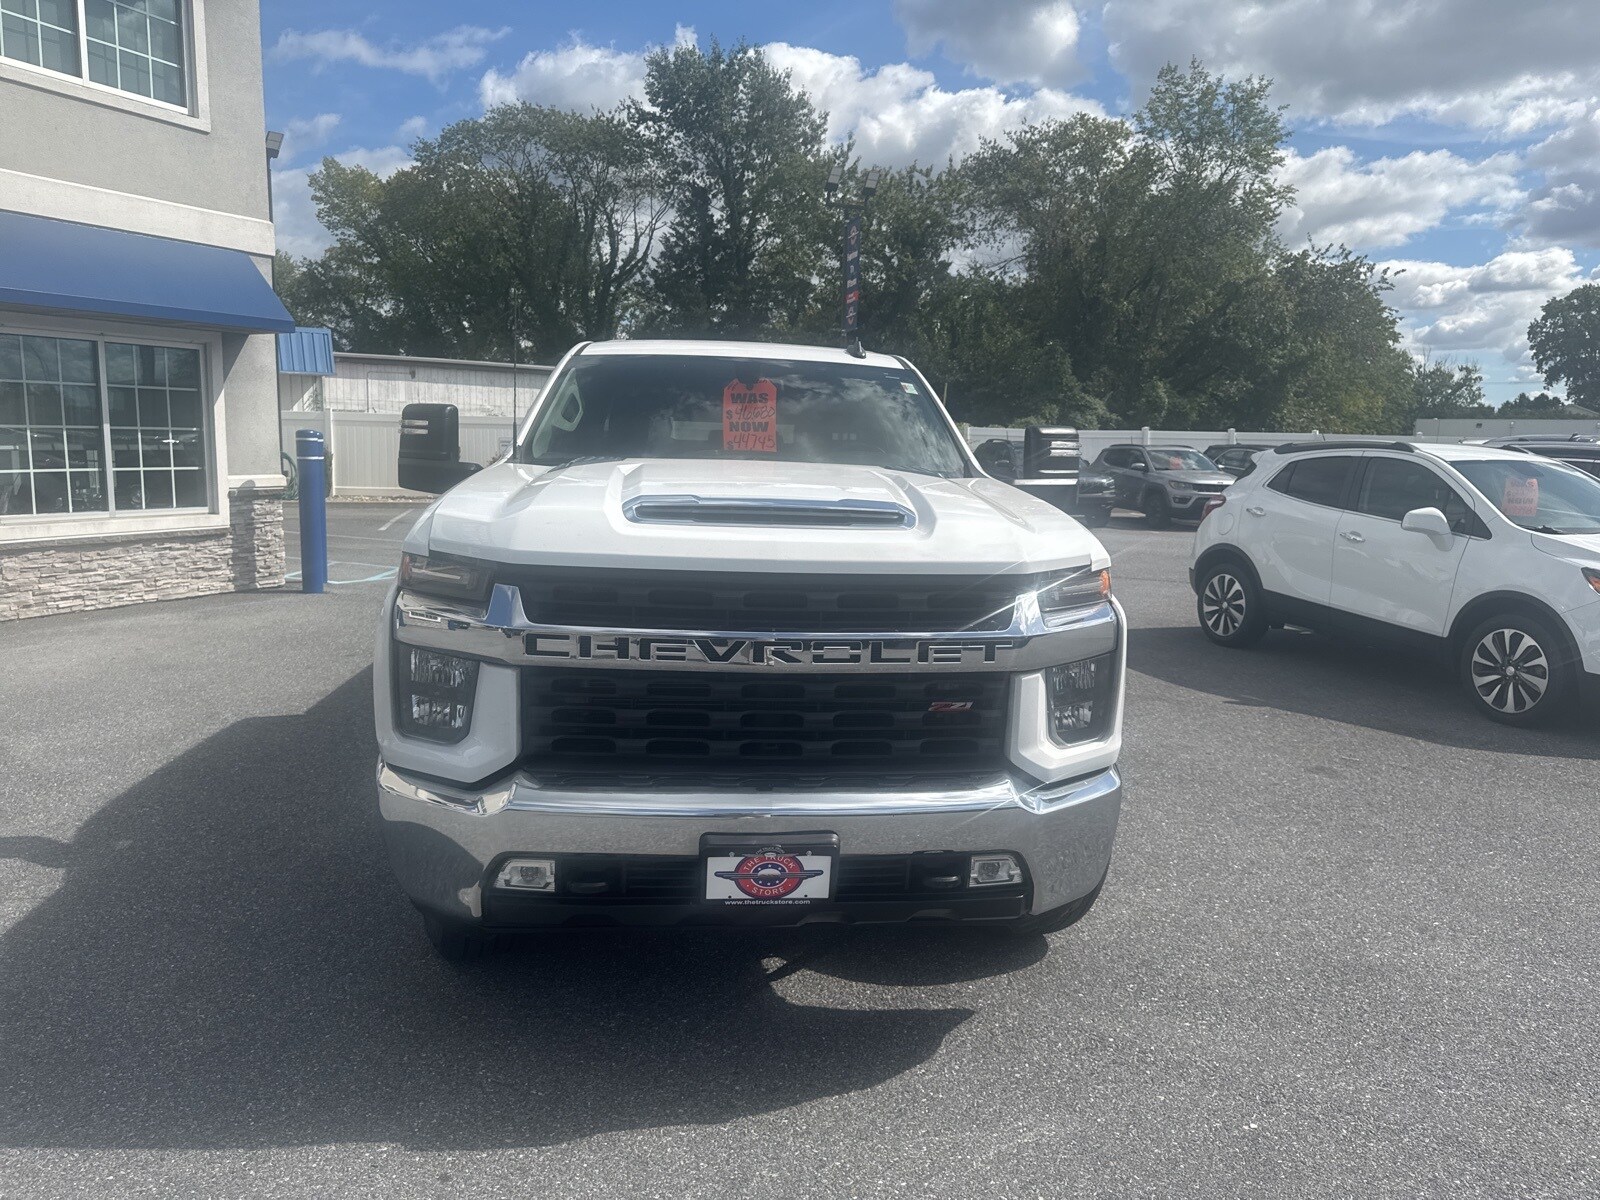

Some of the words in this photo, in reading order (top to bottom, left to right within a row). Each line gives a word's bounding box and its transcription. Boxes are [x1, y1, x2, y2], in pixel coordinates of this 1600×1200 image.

[731, 393, 769, 403] WAS
[729, 422, 769, 432] NOW
[522, 632, 1013, 664] CHEVROLET
[743, 856, 761, 871] THE
[765, 855, 796, 869] TRUCK
[752, 886, 786, 896] STORE
